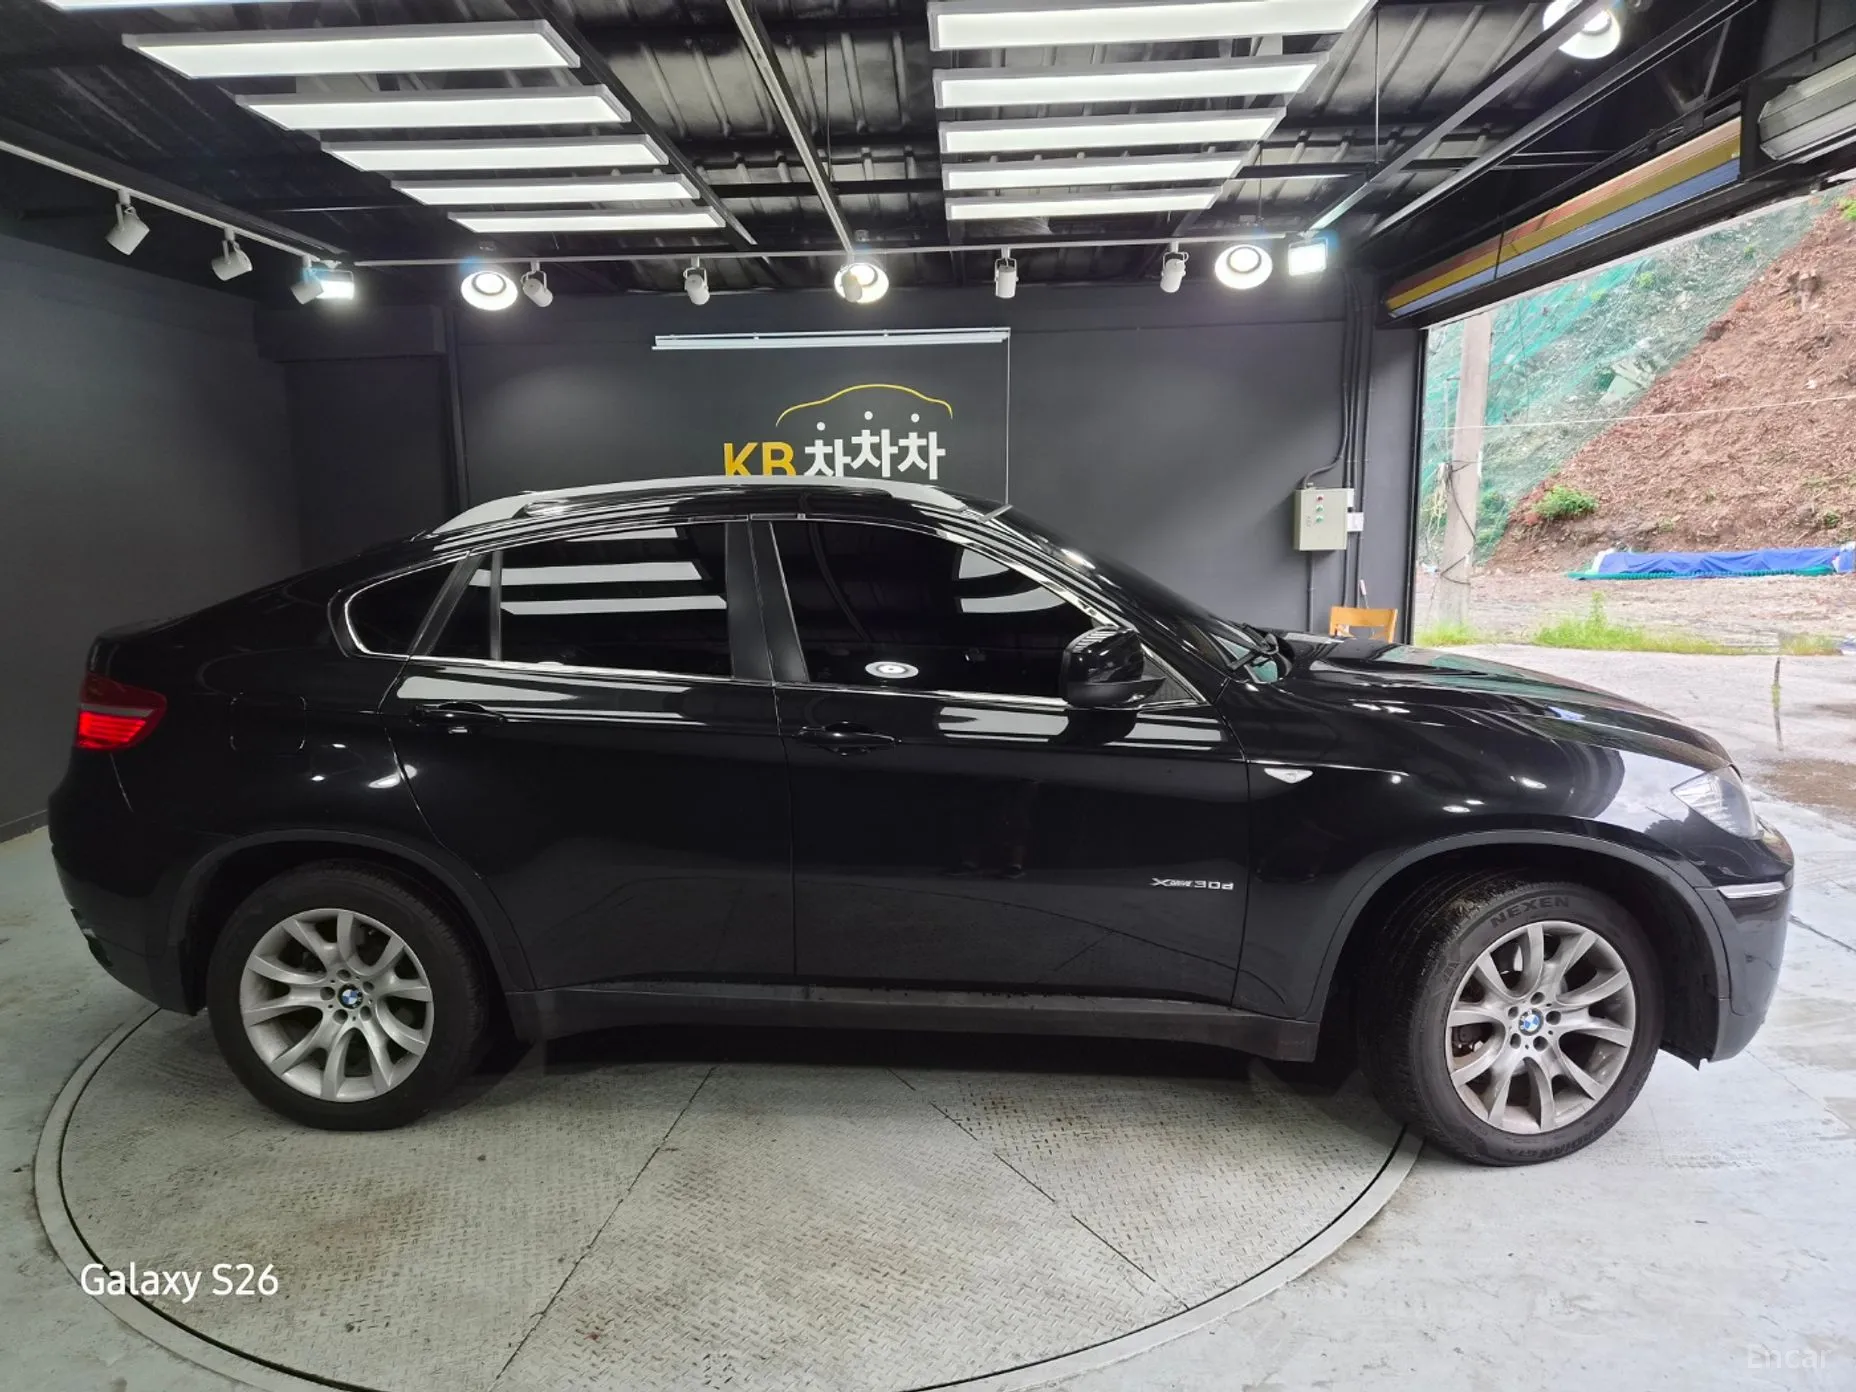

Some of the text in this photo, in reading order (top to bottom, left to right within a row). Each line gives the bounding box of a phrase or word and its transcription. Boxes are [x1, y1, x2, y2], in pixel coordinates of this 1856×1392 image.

[723, 411, 947, 480] KB 차차차
[1490, 896, 1569, 928] NEXEN
